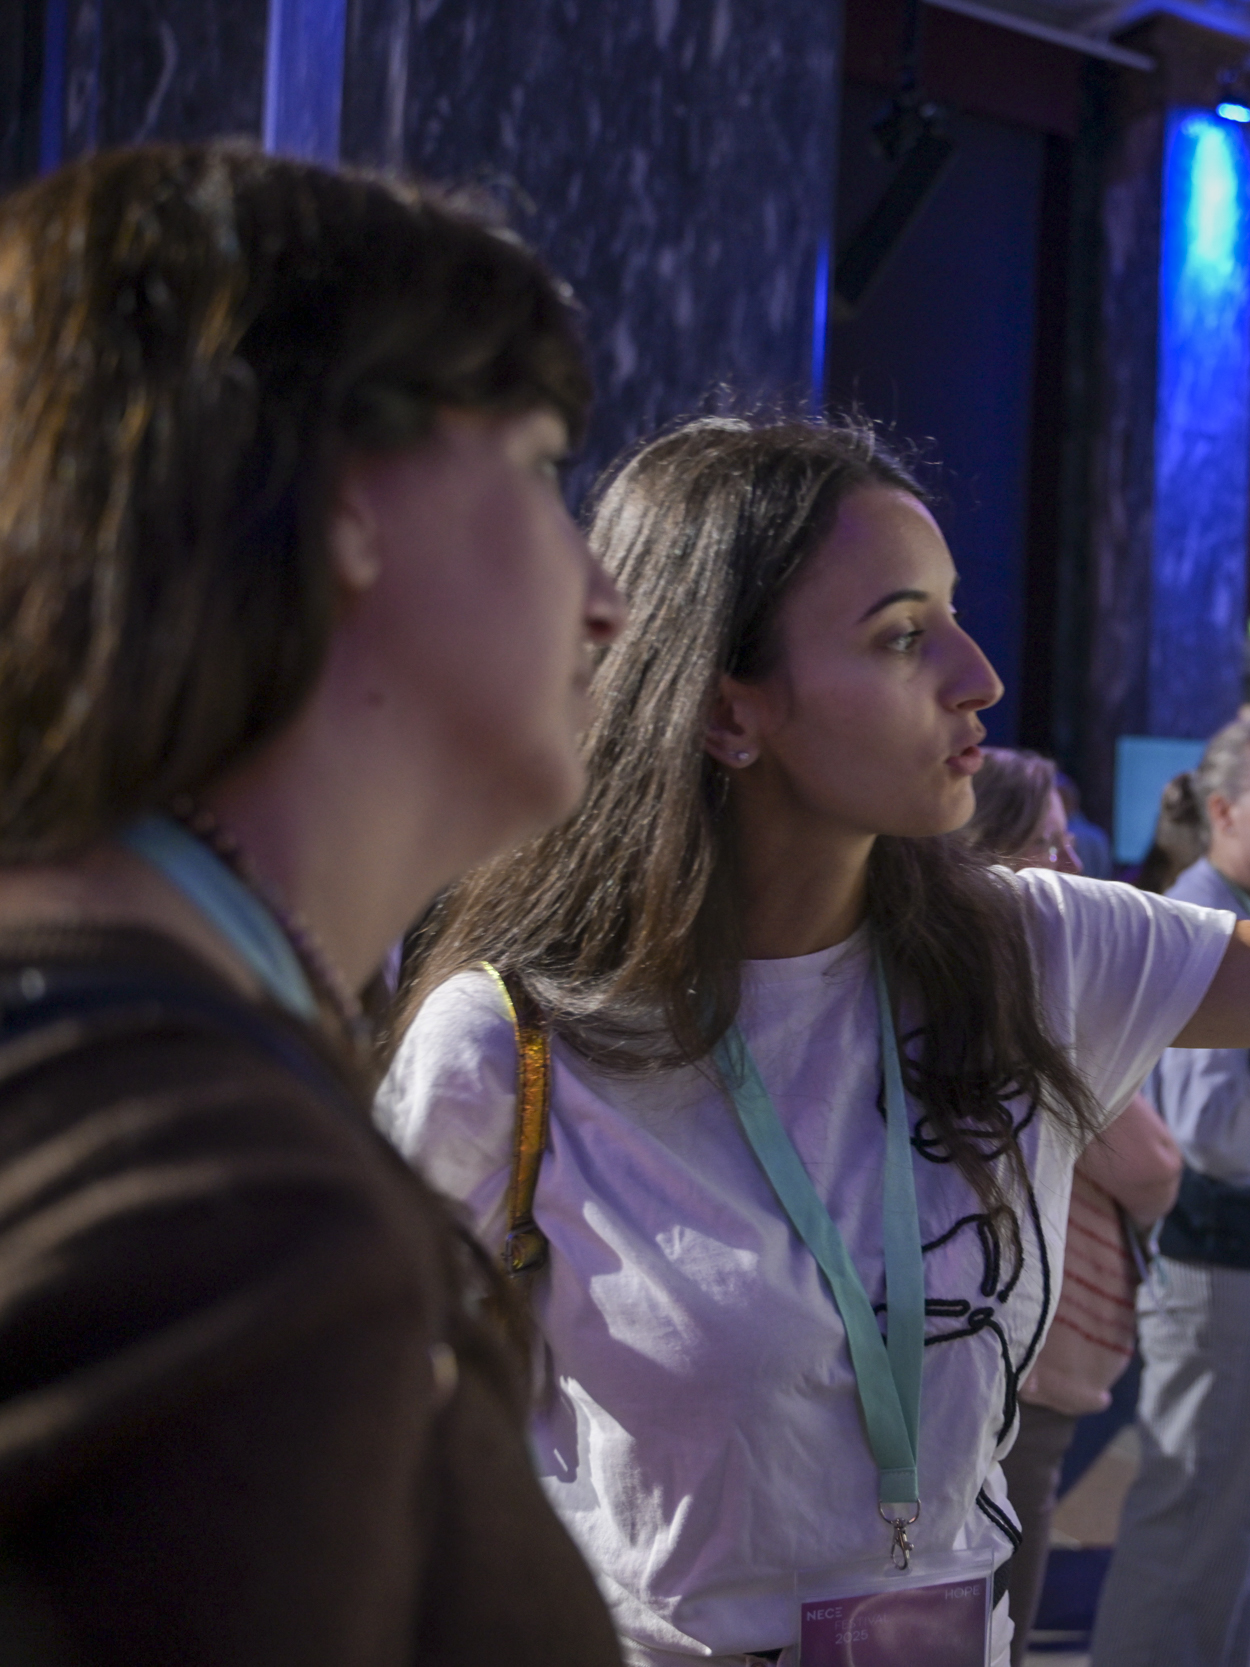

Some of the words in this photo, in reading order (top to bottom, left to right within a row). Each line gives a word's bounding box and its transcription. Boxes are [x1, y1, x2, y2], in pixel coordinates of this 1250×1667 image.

[944, 1584, 981, 1600] HOPE
[806, 1606, 843, 1621] NECE
[835, 1614, 889, 1631] FESTIVAL
[835, 1629, 869, 1645] 2025
